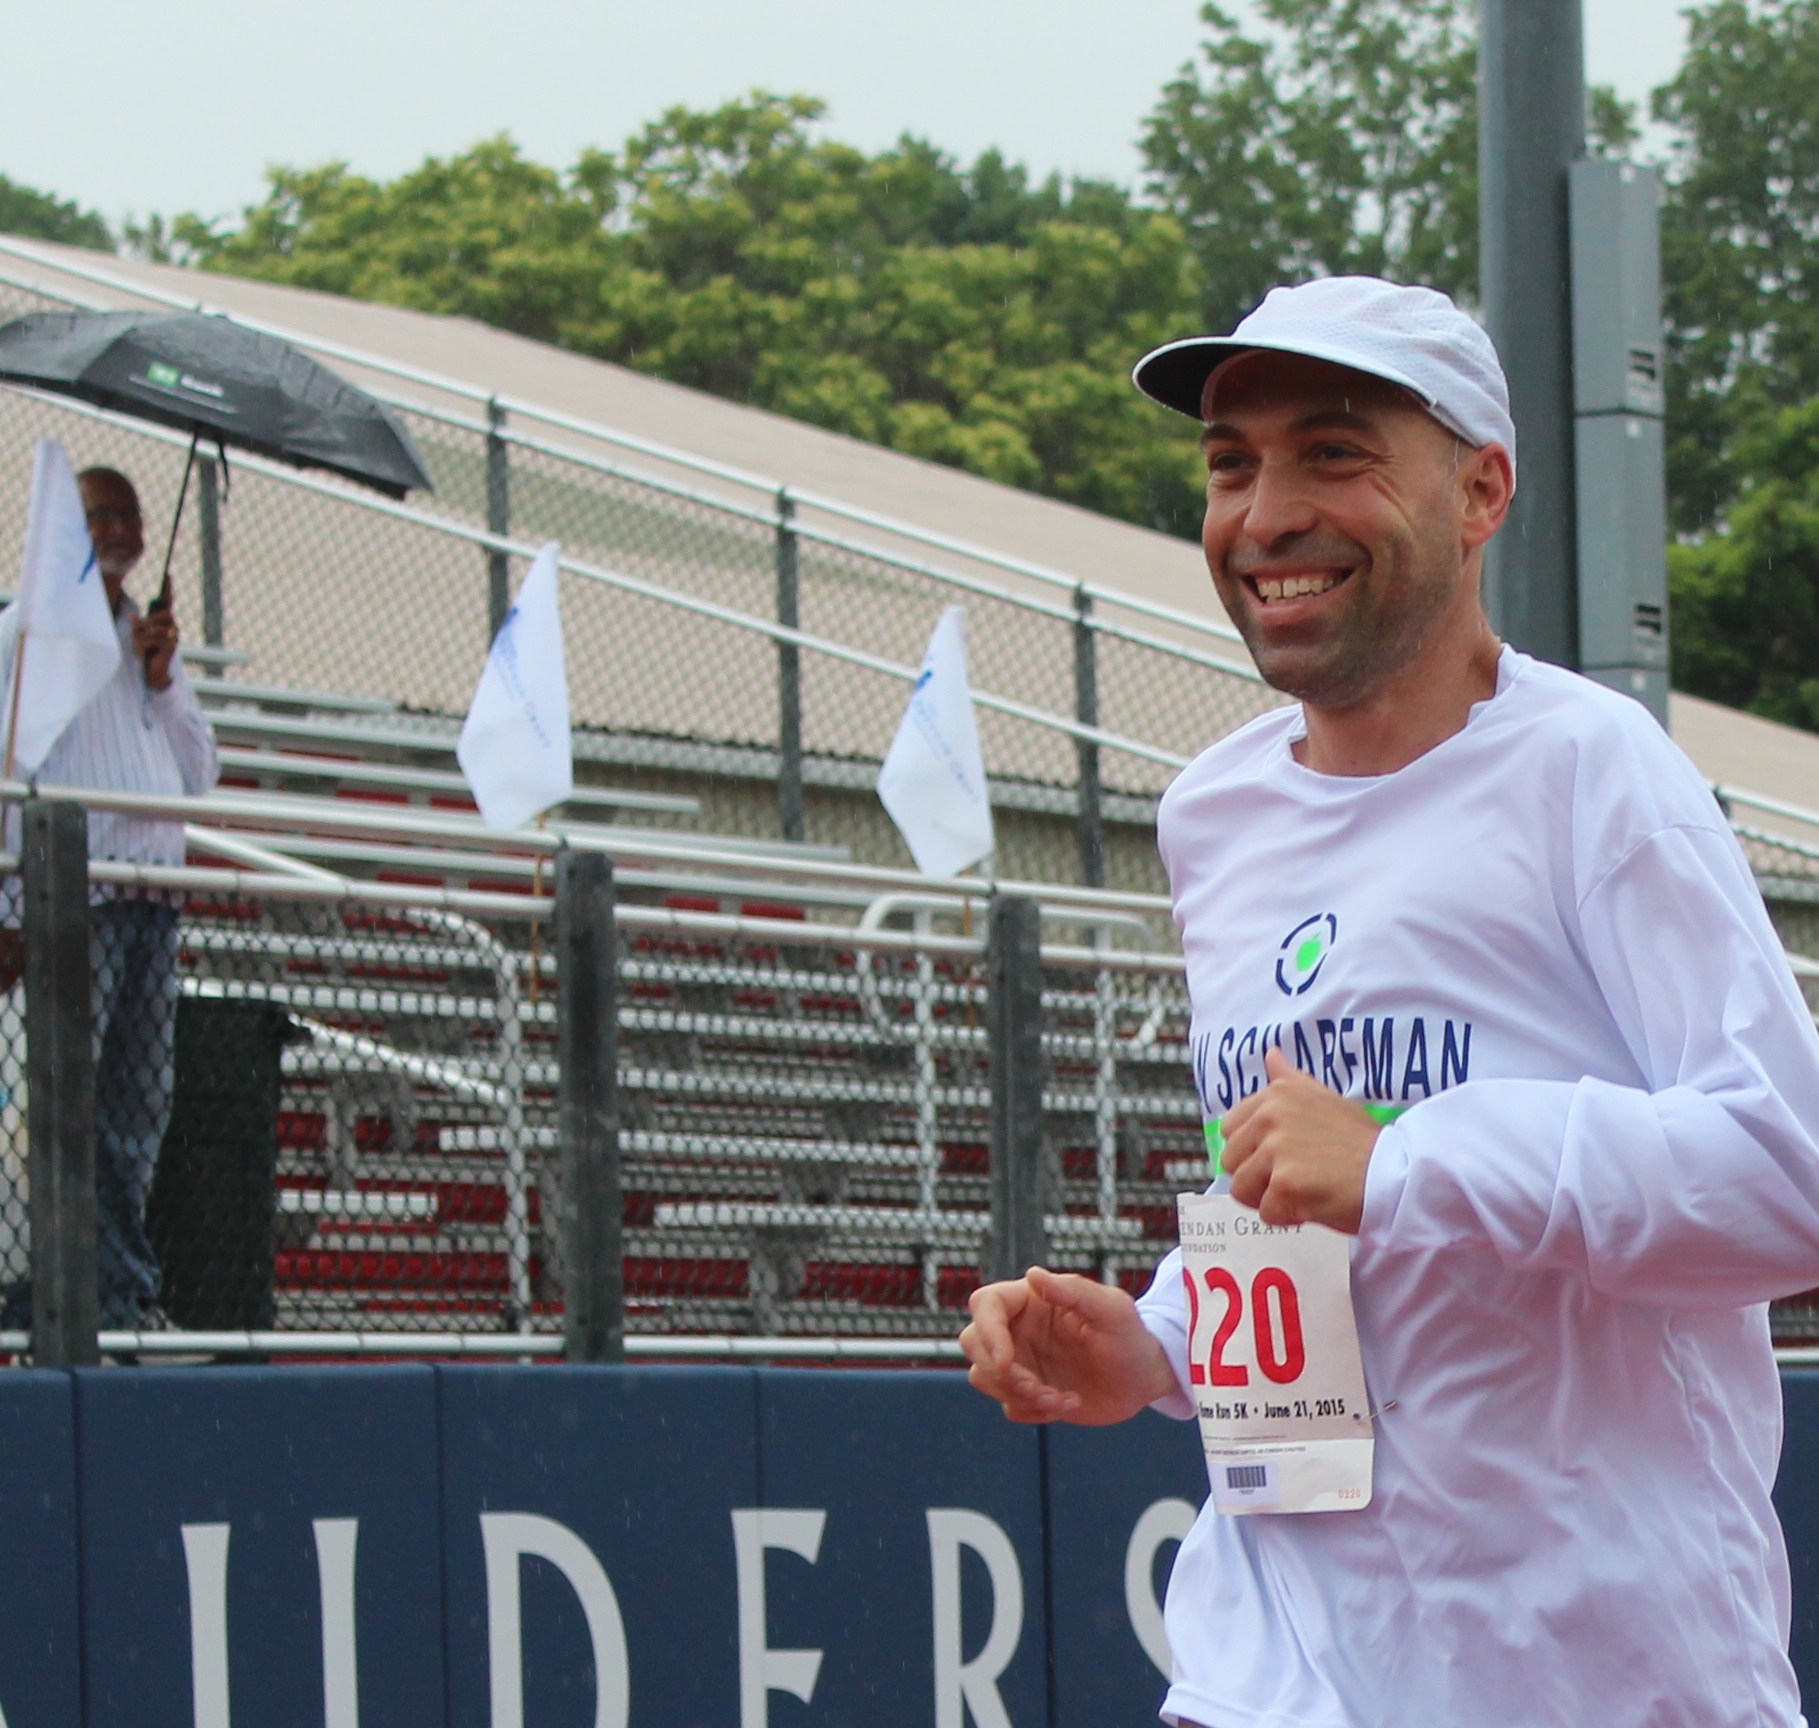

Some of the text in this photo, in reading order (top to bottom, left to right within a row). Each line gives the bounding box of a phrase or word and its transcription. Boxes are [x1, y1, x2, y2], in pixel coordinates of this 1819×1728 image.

[1234, 1402, 1249, 1418] 5K
[1264, 1401, 1290, 1418] June
[1293, 1401, 1313, 1420] 21,
[1316, 1399, 1345, 1416] 2015
